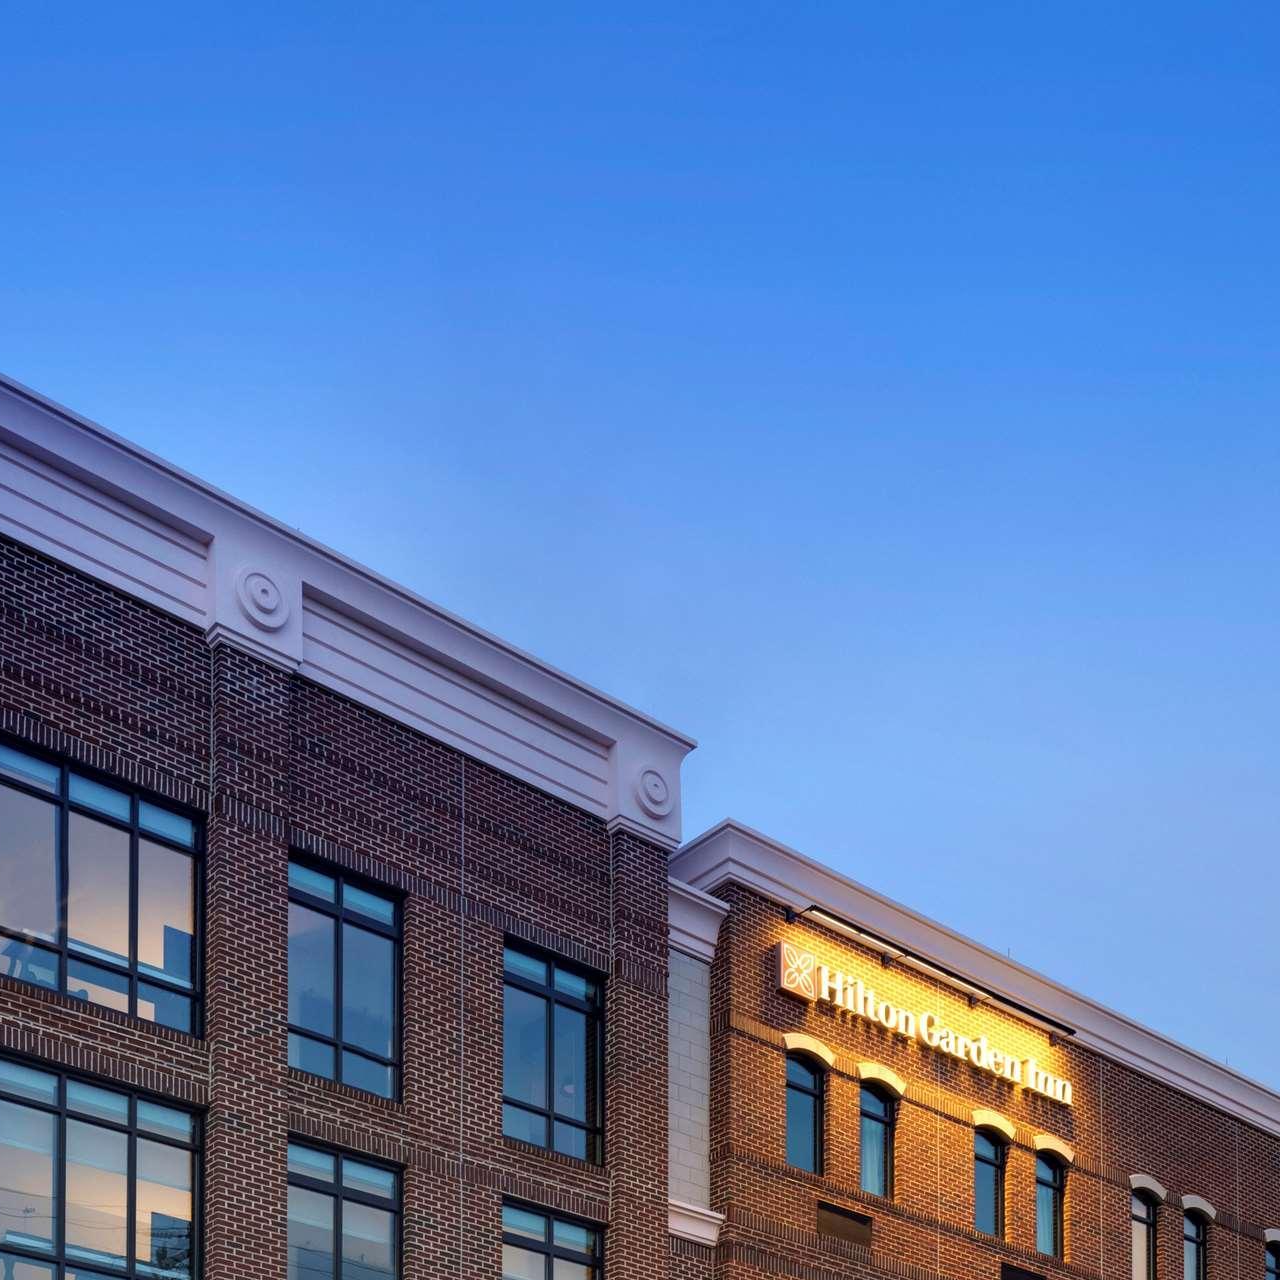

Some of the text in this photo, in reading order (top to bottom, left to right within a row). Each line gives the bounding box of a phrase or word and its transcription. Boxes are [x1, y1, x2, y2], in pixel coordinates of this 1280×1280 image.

[818, 965, 1072, 1105] Hilton Garden Inn
